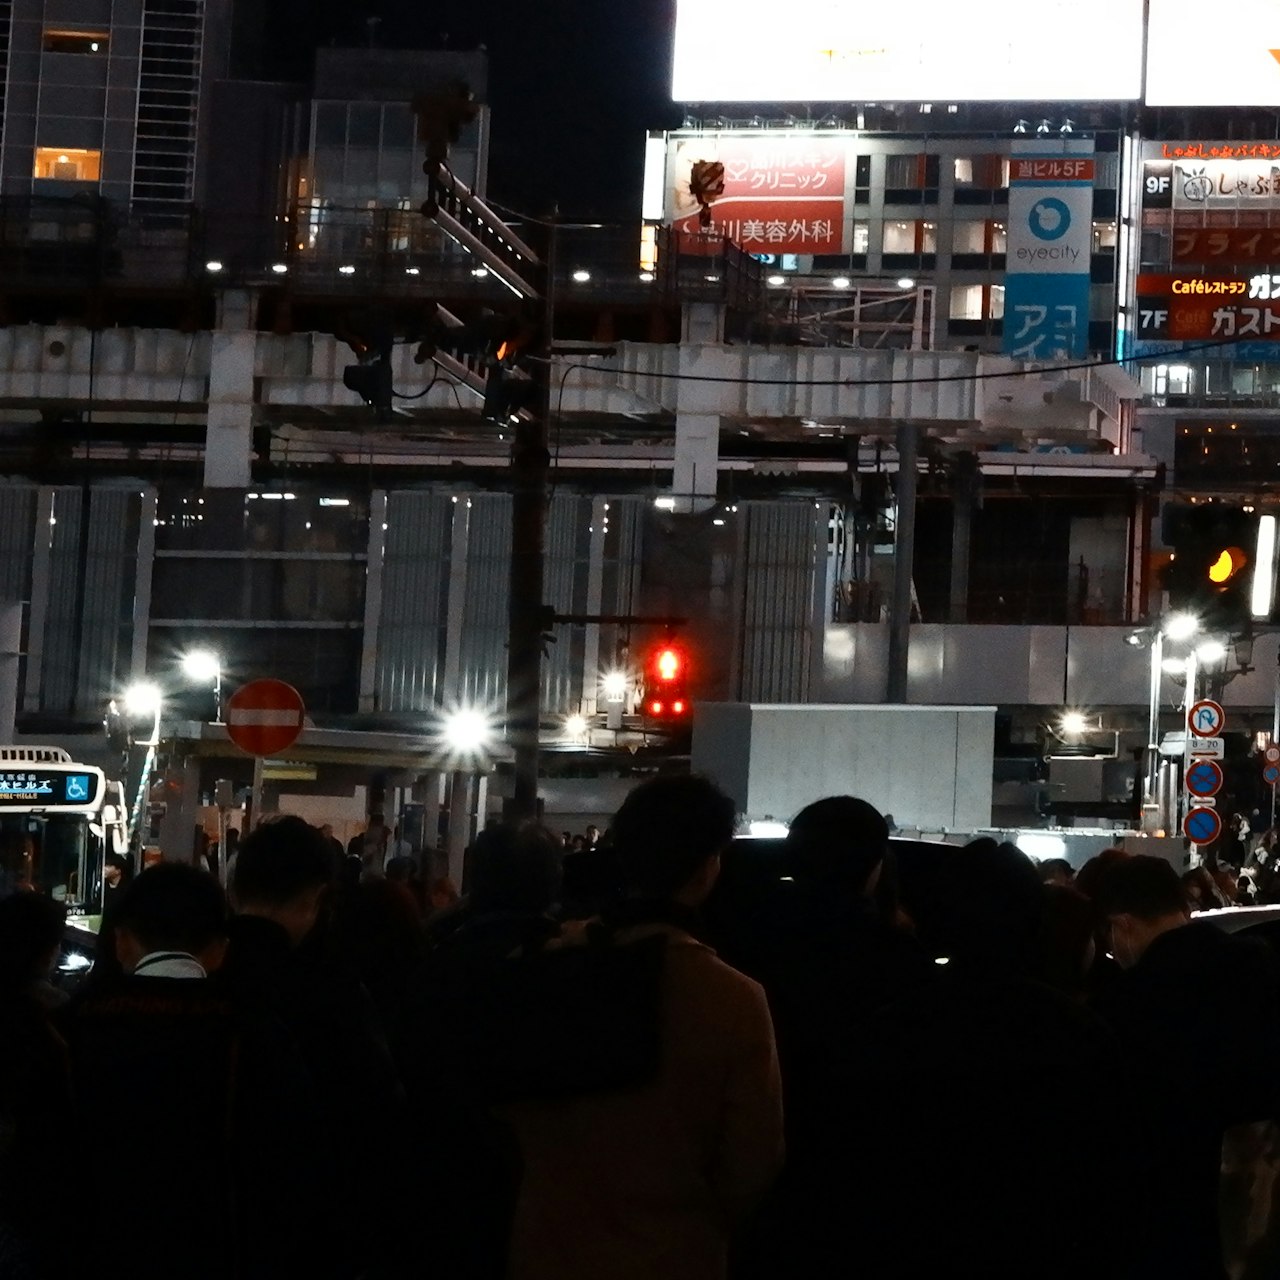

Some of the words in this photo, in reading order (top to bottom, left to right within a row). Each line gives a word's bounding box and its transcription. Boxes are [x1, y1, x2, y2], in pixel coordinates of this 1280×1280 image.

[749, 149, 839, 172] 品川スキン
[1018, 161, 1086, 178] 当ビル5F
[750, 171, 828, 190] クリニック
[1146, 176, 1170, 194] 9F
[1015, 245, 1081, 265] eyecity
[1172, 279, 1246, 295] Caféレストラン
[1140, 309, 1169, 330] 7F
